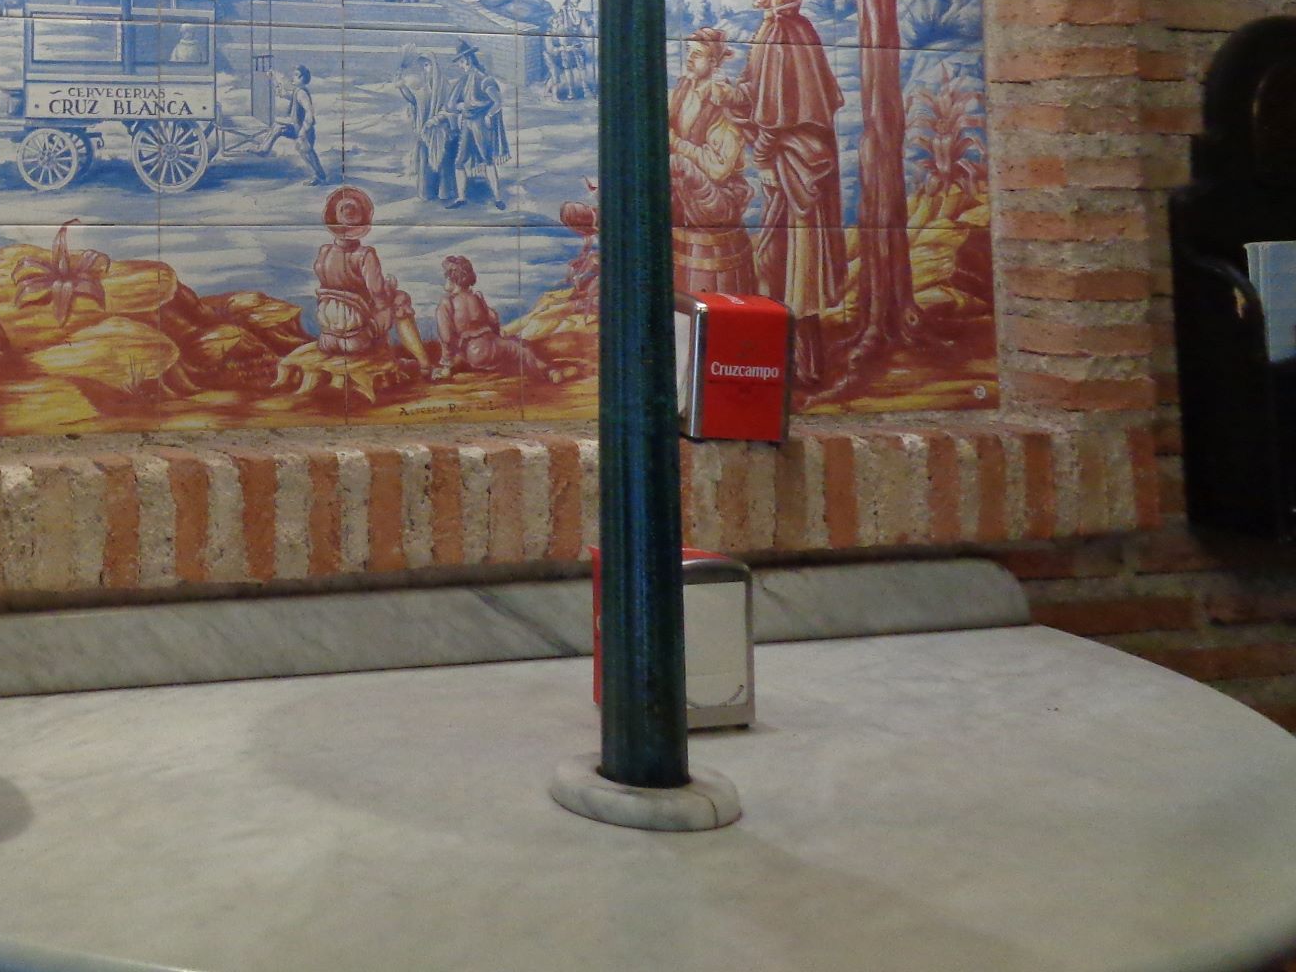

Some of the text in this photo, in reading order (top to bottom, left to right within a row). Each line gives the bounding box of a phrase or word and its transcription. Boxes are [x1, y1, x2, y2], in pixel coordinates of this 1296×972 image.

[68, 87, 166, 98] CERVECERIAS
[48, 99, 193, 116] CRUZ BLANCA
[710, 361, 779, 380] Cruzcampo
